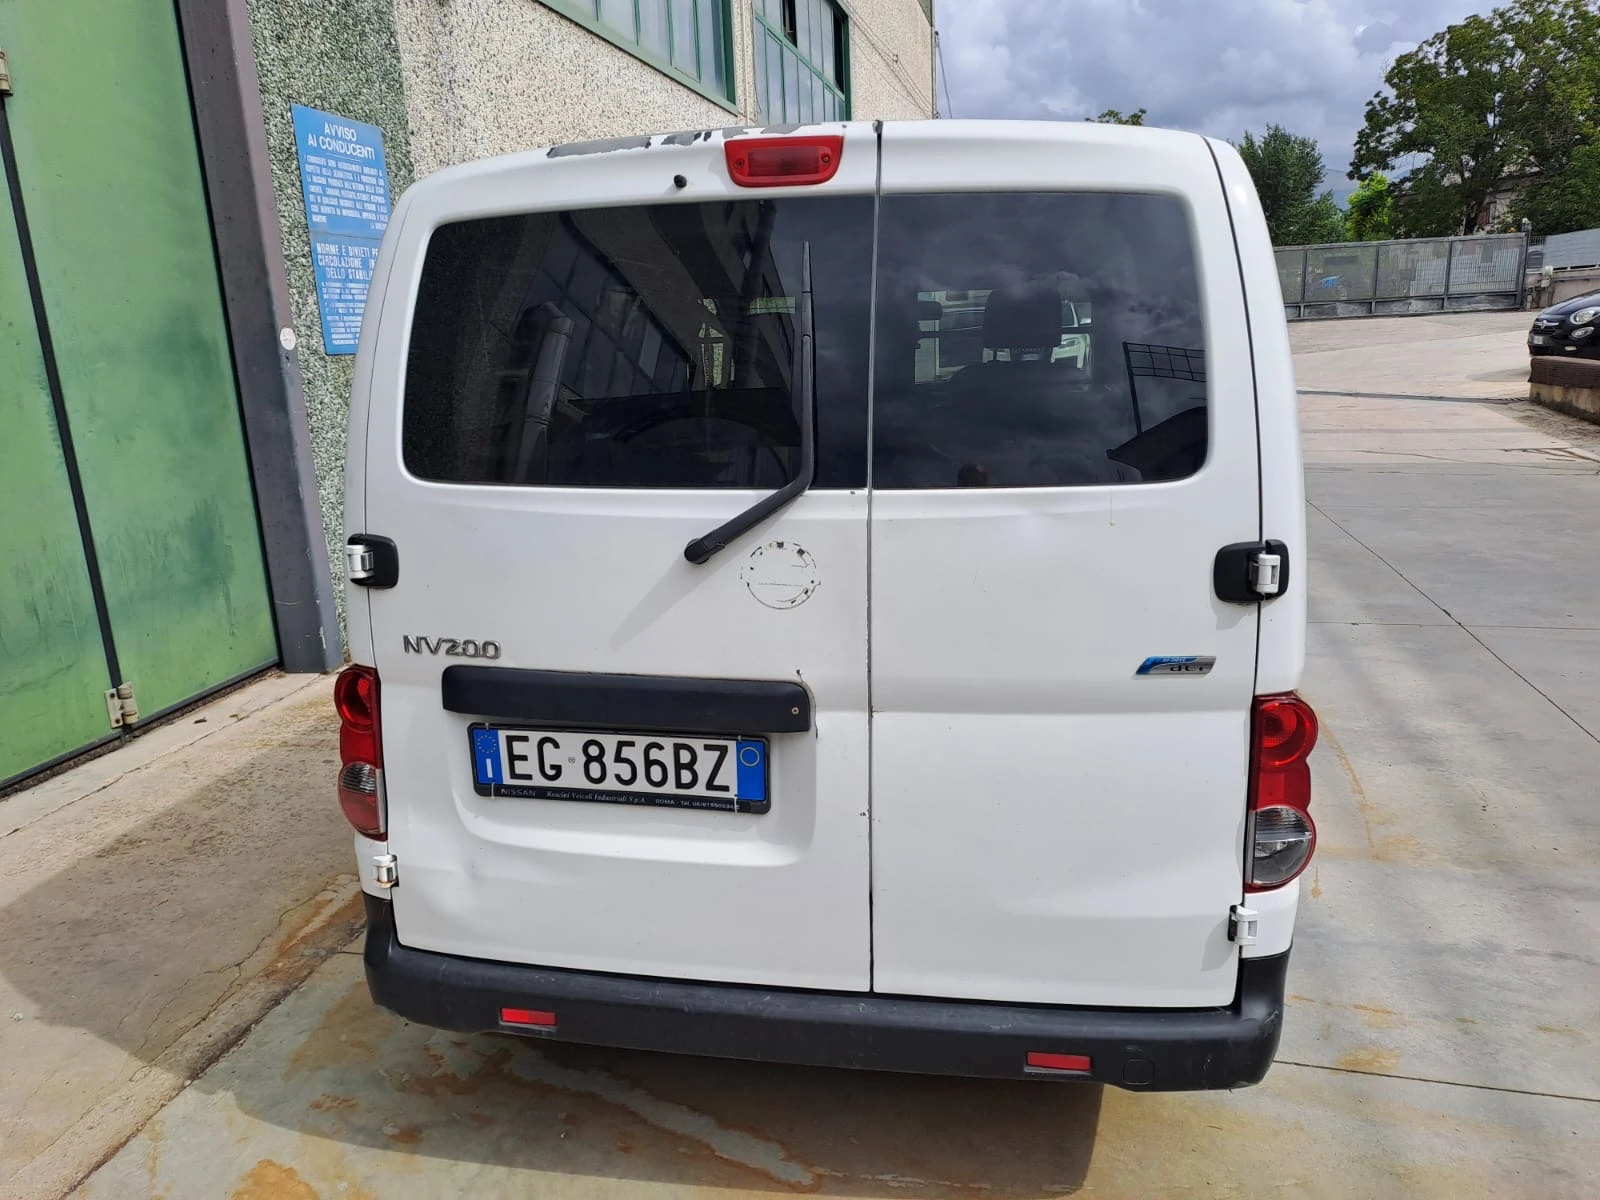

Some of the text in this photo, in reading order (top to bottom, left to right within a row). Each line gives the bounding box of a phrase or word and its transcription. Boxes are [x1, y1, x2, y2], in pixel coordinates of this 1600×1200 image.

[324, 122, 356, 141] AVVISO
[308, 133, 375, 160] AI CONDUCENTI
[316, 243, 339, 255] NORME
[342, 246, 347, 256] E
[317, 255, 362, 268] CIRCOLAZIONE
[326, 267, 346, 279] DELLO
[403, 635, 501, 660] NV200
[505, 735, 730, 792] EG 856BZ
[500, 788, 536, 797] NISSAN
